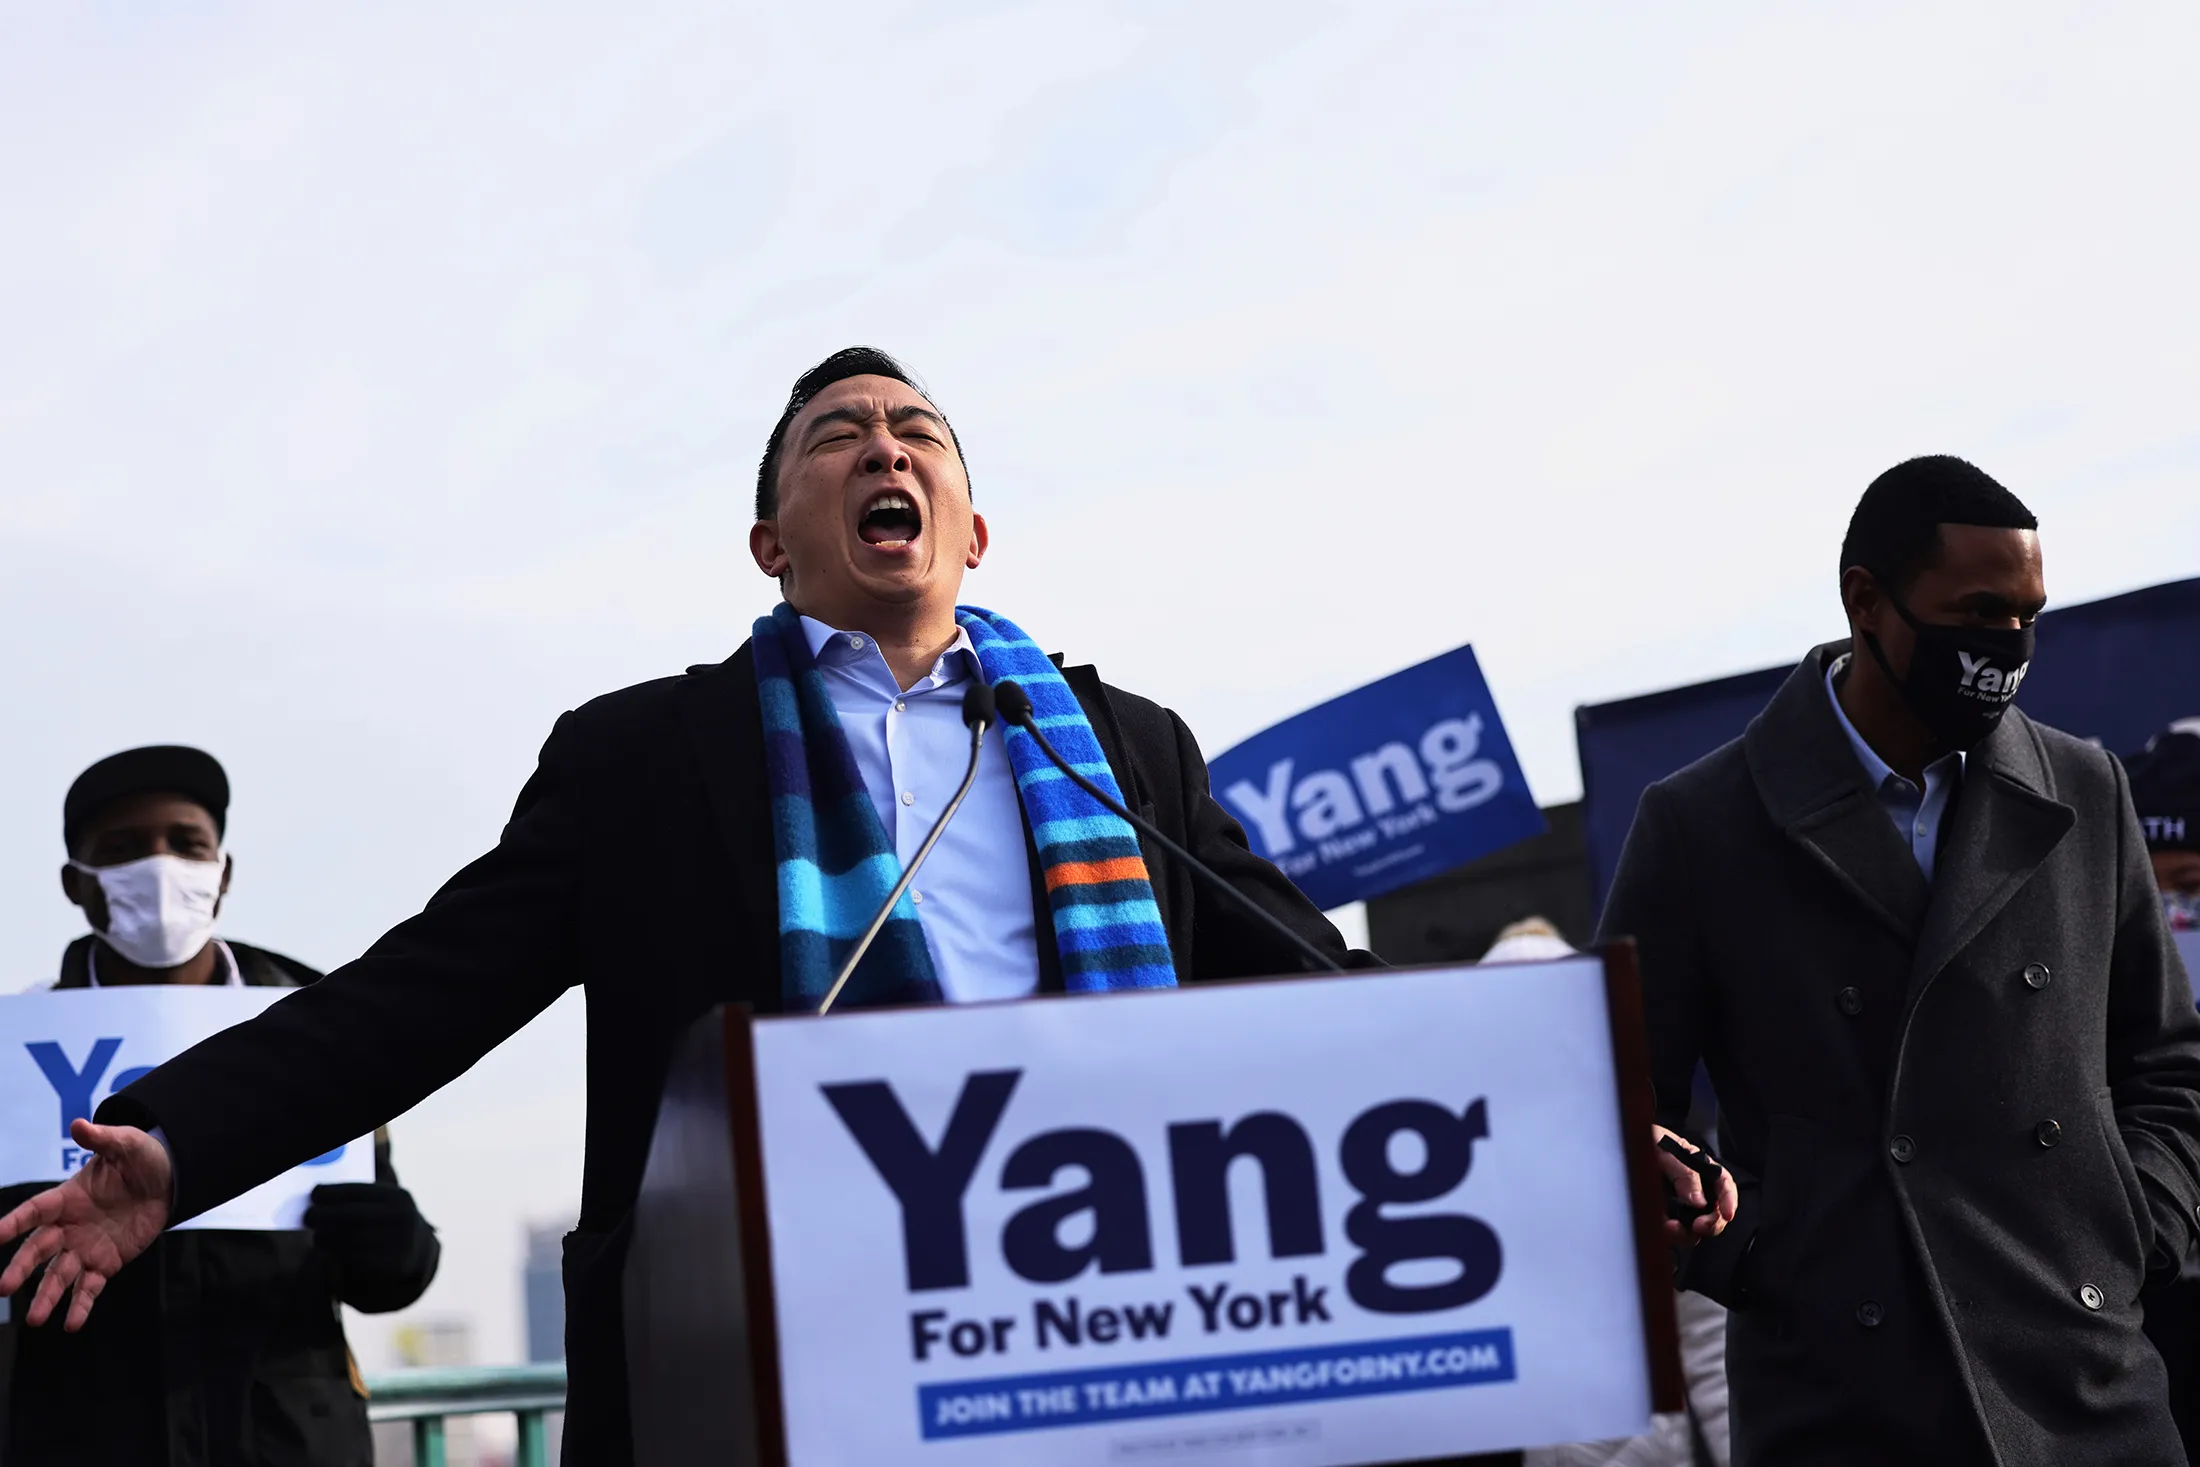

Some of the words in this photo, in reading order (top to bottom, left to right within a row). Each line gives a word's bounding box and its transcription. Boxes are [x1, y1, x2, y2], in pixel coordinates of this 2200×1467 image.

[1957, 686, 1976, 698] For
[1976, 692, 2000, 703] New
[1223, 711, 1504, 857] Yang
[1318, 828, 1378, 865] New
[1377, 802, 1439, 840] York
[2139, 816, 2186, 841] TH
[816, 1066, 1505, 1315] Yang
[910, 1309, 1016, 1362] For
[1033, 1295, 1174, 1350] New
[1185, 1274, 1333, 1335] York
[936, 1389, 1012, 1427] JOIN
[1016, 1383, 1079, 1417] THE
[1082, 1375, 1178, 1411] TEAM
[1182, 1370, 1224, 1400] AT
[1226, 1343, 1501, 1396] YANGFORNY.COM
